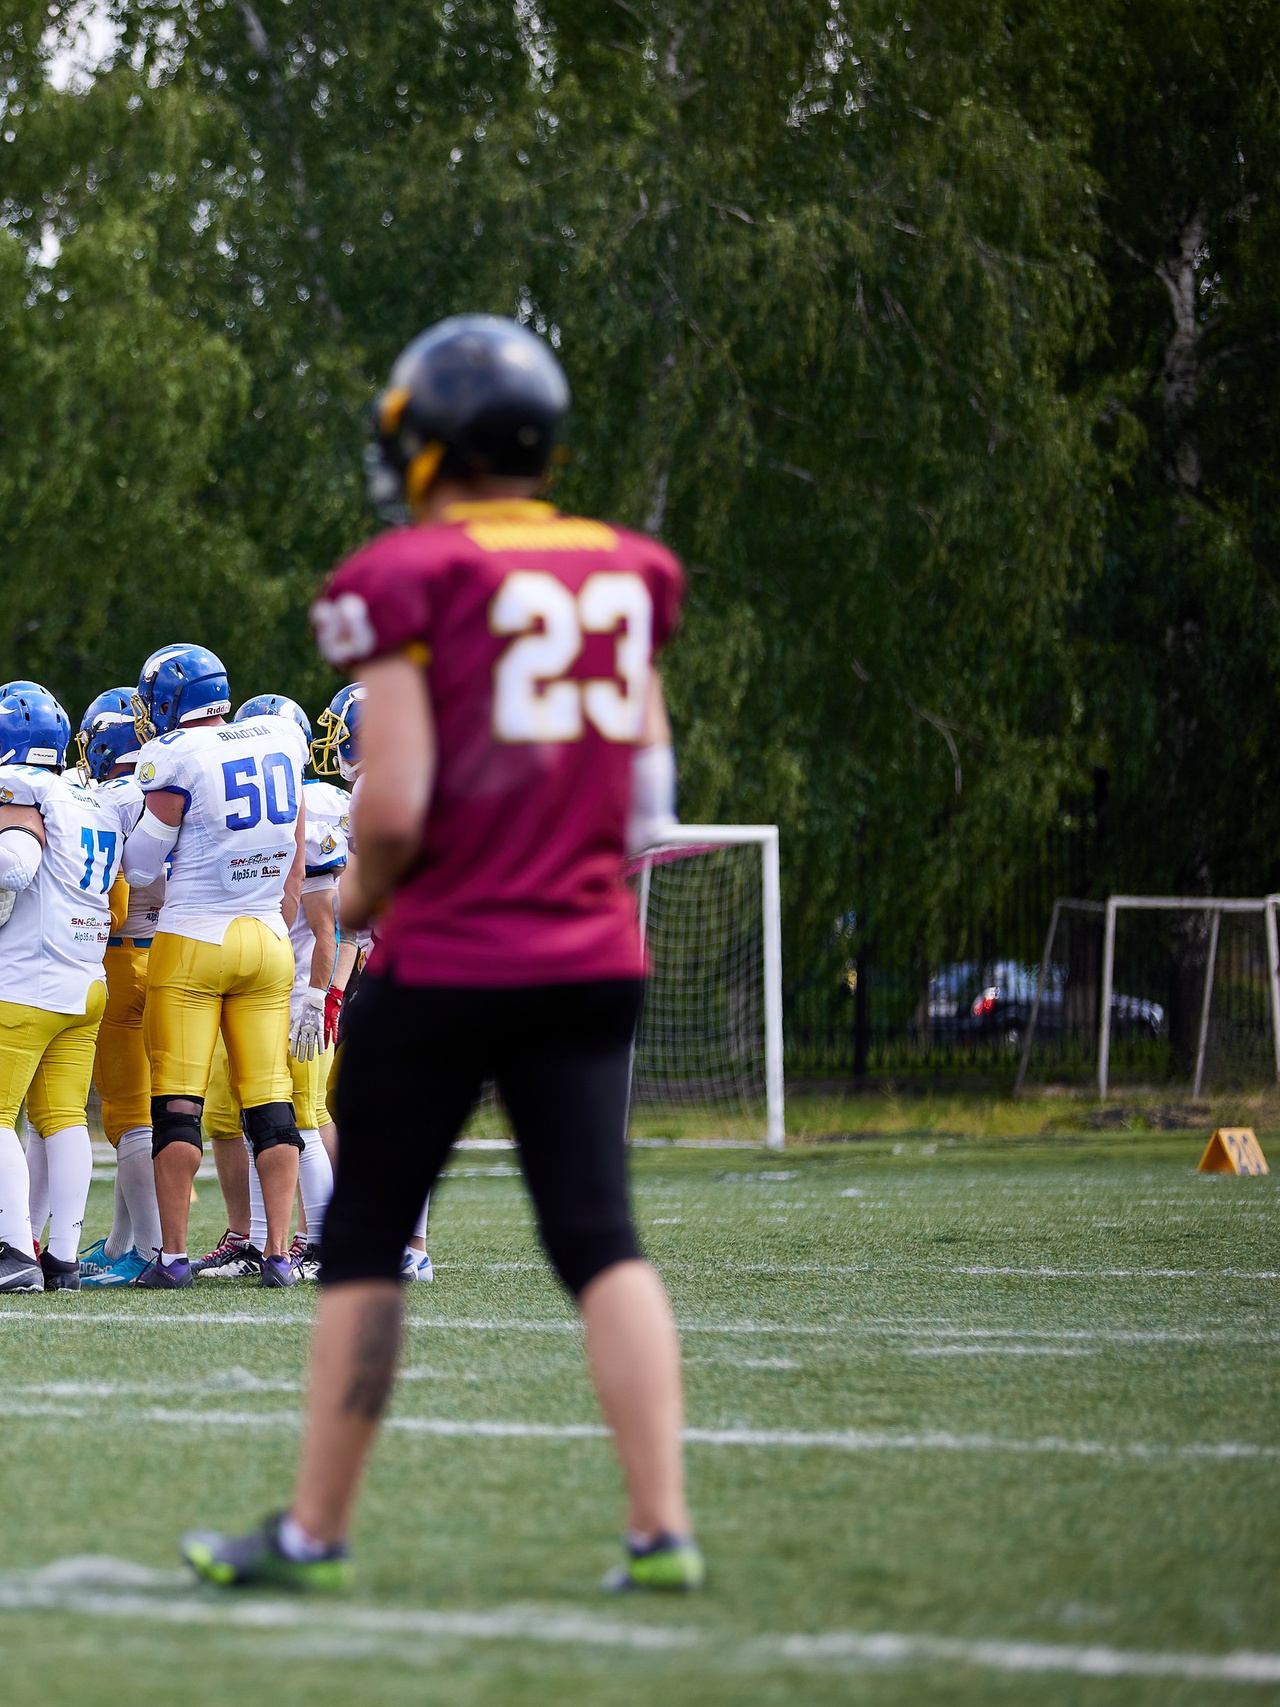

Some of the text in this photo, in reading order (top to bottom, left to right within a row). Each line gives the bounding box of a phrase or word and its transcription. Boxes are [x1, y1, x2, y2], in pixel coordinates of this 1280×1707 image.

[490, 570, 654, 744] 23
[217, 725, 271, 742] ВОЛОГДА
[222, 752, 298, 831] 50
[80, 826, 117, 895] 77
[231, 868, 258, 882] Alp35.ru
